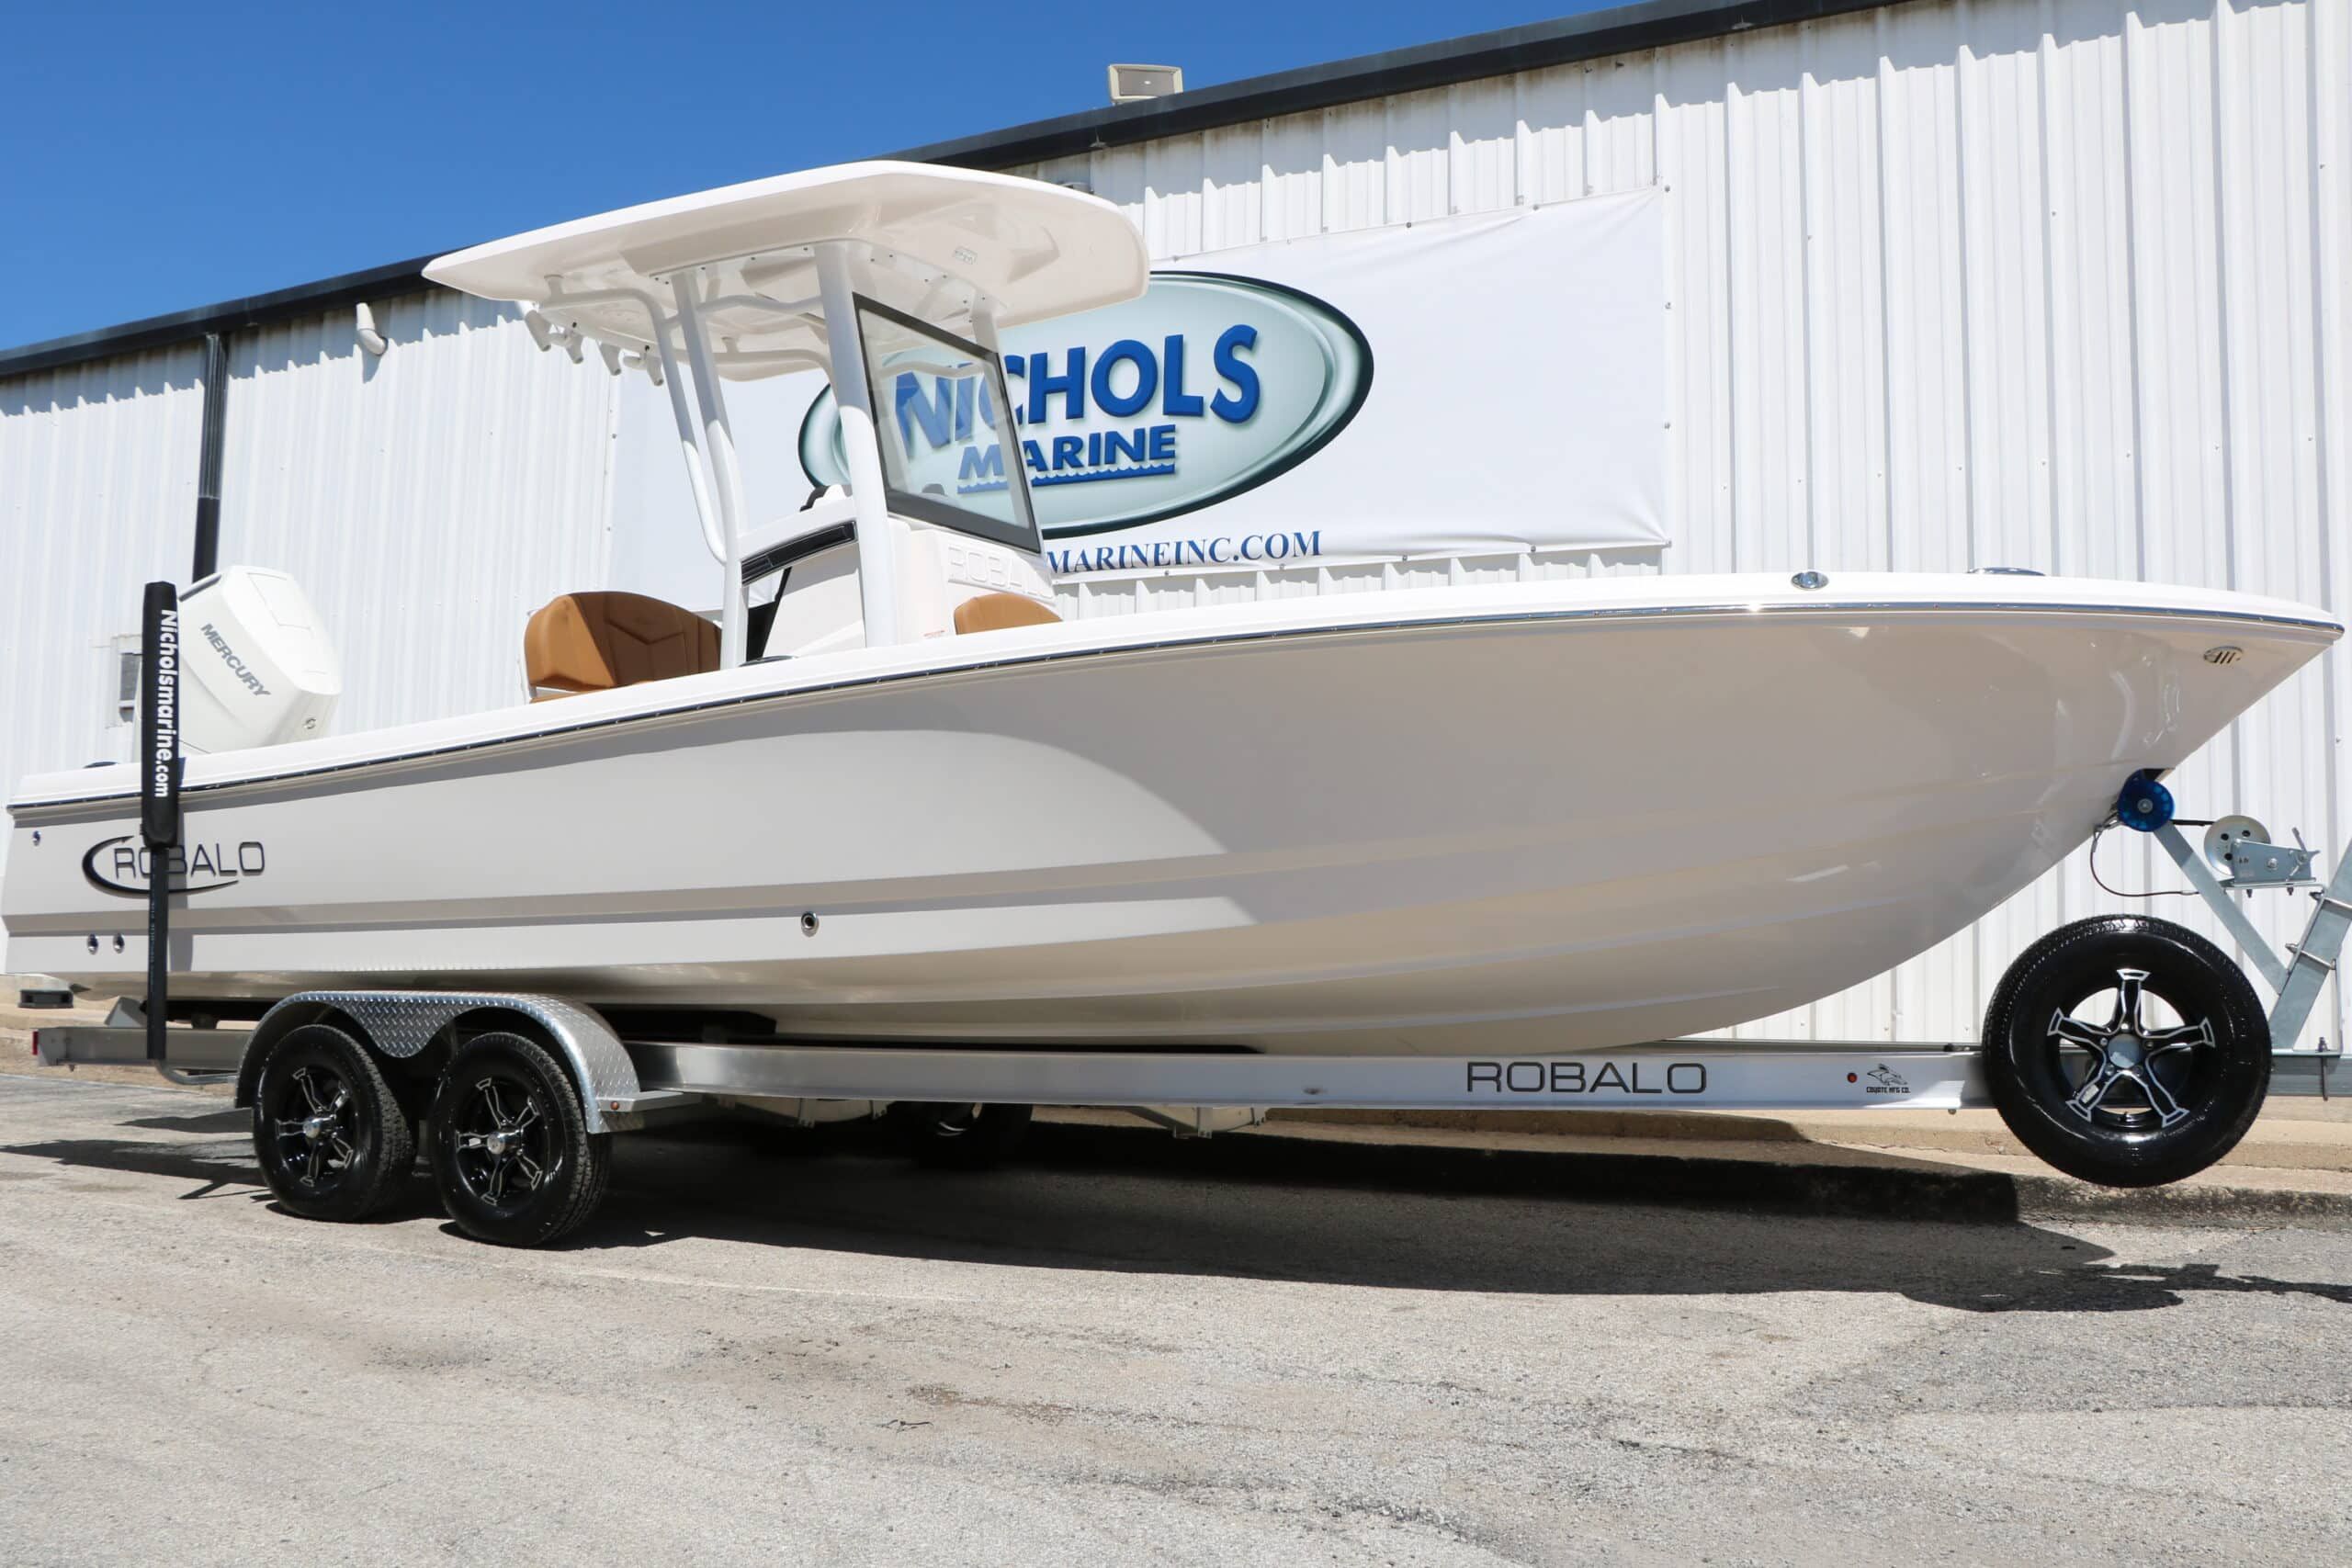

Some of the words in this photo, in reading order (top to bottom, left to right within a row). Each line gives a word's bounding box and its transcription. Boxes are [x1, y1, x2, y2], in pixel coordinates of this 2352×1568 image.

[896, 323, 1261, 463] NICHOLS
[958, 423, 1176, 479] MARINE
[200, 623, 271, 696] MERCURY
[153, 609, 178, 797] Nicholsmarine.com
[1466, 1061, 1707, 1094] ROBALO
